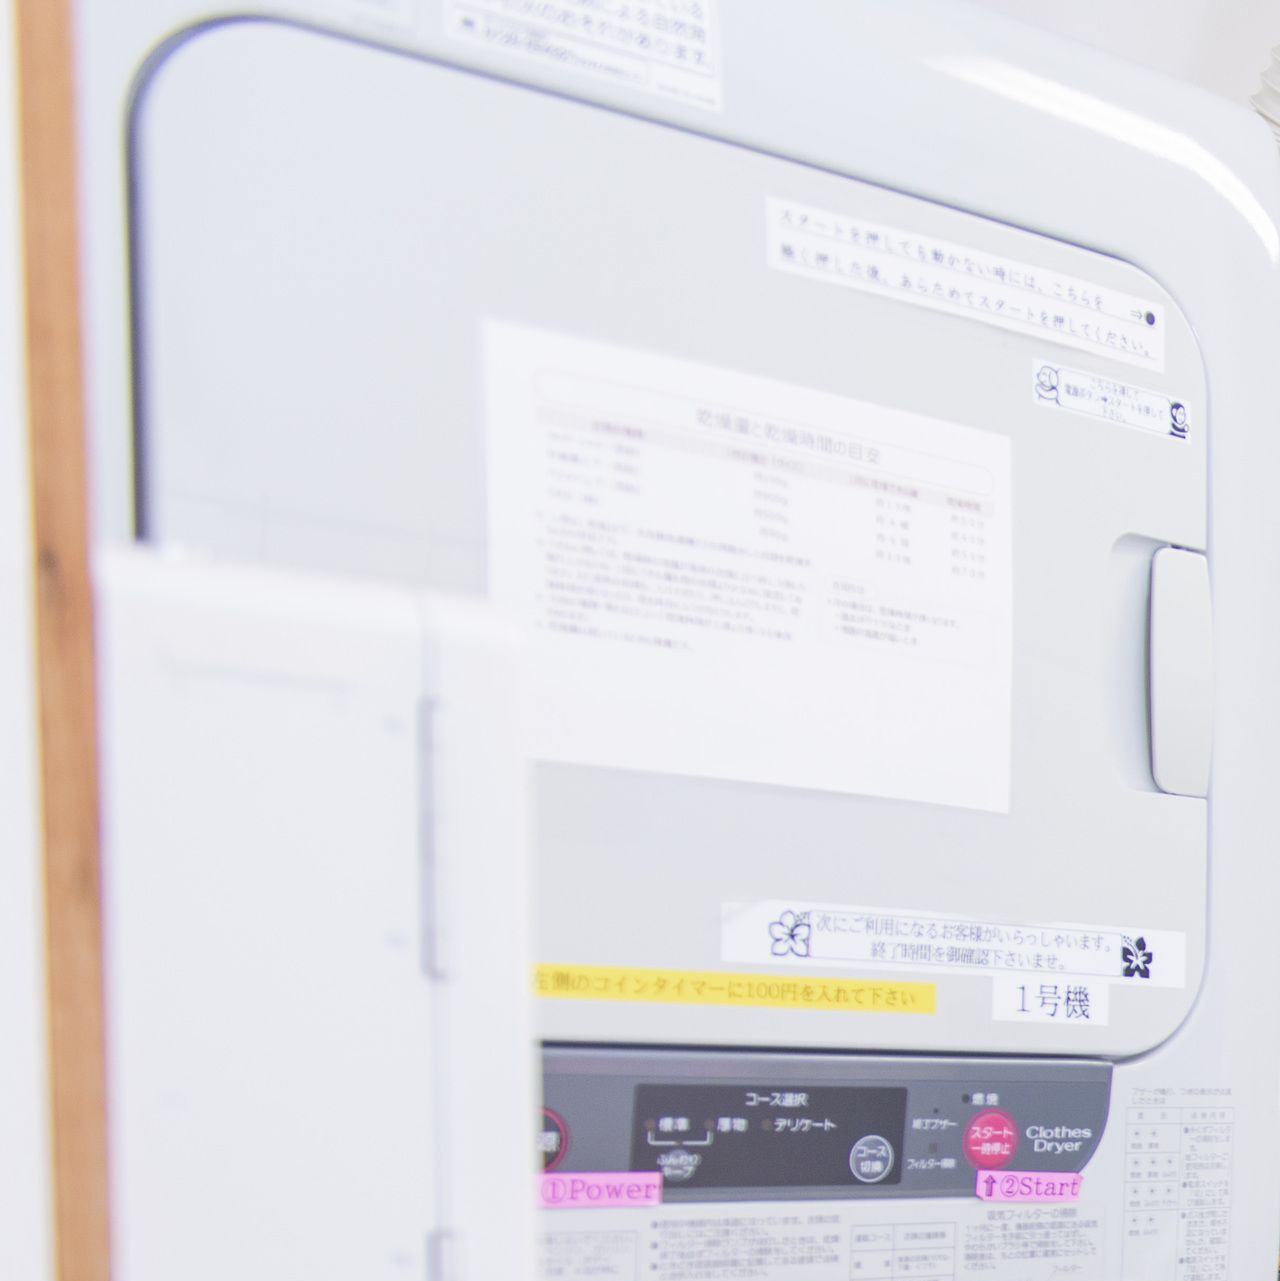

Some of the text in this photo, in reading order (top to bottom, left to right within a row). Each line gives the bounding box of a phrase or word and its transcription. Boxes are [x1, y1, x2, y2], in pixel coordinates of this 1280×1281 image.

[816, 913, 1111, 952] 次にご利用になるお客様がいらっしゃいます。
[870, 941, 1065, 971] 終了時間を御確認下さいませ。
[1015, 985, 1091, 1019] 1号機
[745, 1092, 808, 1107] コース選択
[774, 1117, 838, 1132] デリケート
[1025, 1125, 1092, 1139] Clothes
[971, 1126, 1014, 1139] スタート
[857, 1146, 887, 1158] コース
[1033, 1139, 1083, 1154] Dryer
[1000, 1174, 1079, 1198] ②Start
